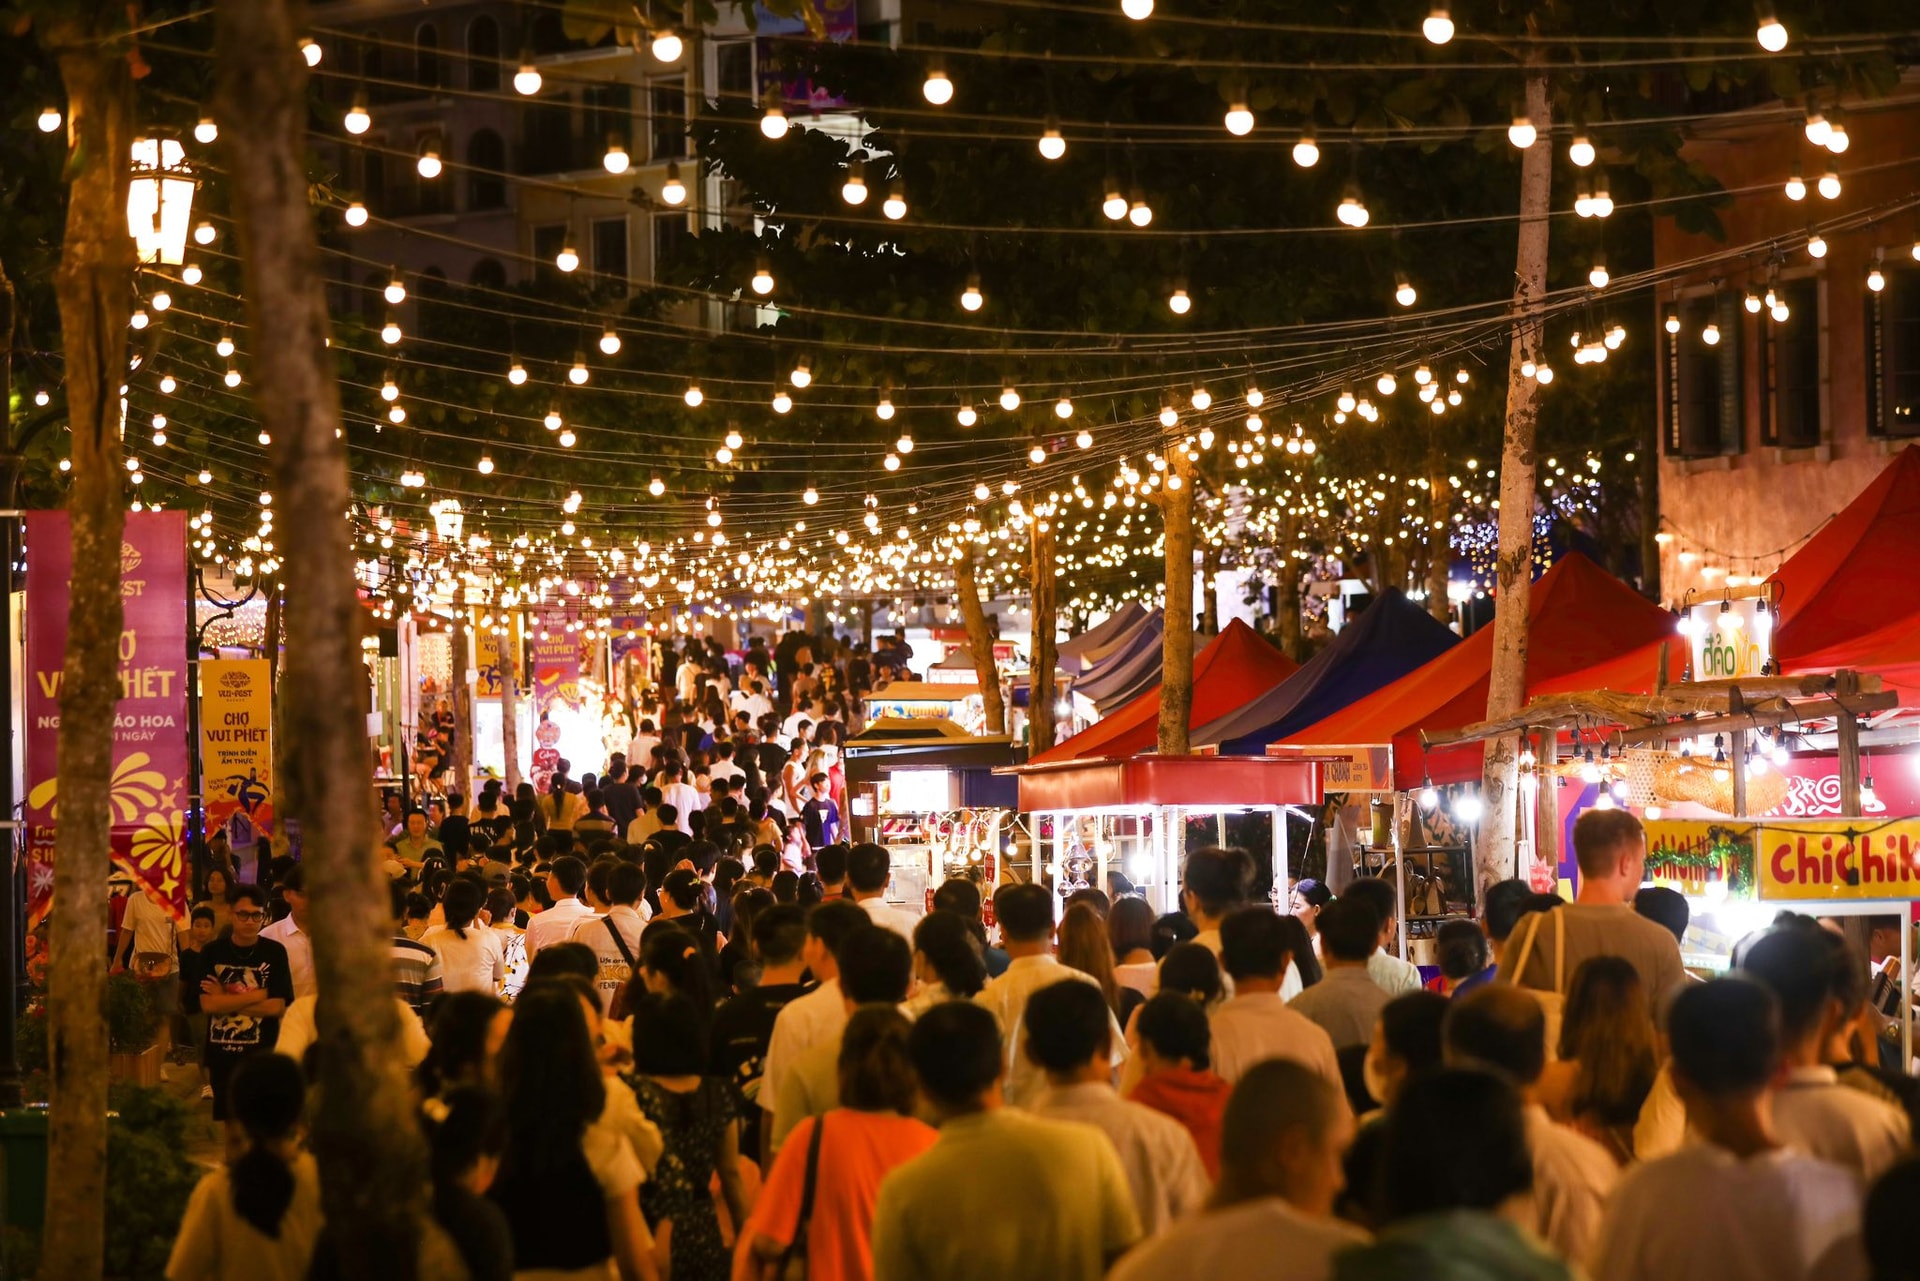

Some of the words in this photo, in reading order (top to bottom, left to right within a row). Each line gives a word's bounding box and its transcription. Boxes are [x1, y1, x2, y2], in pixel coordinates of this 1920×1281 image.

[117, 666, 176, 698] HẾT
[140, 716, 175, 727] HOA
[224, 712, 249, 727] CHỢ
[207, 729, 231, 742] VUI
[234, 728, 267, 742] PHẾT
